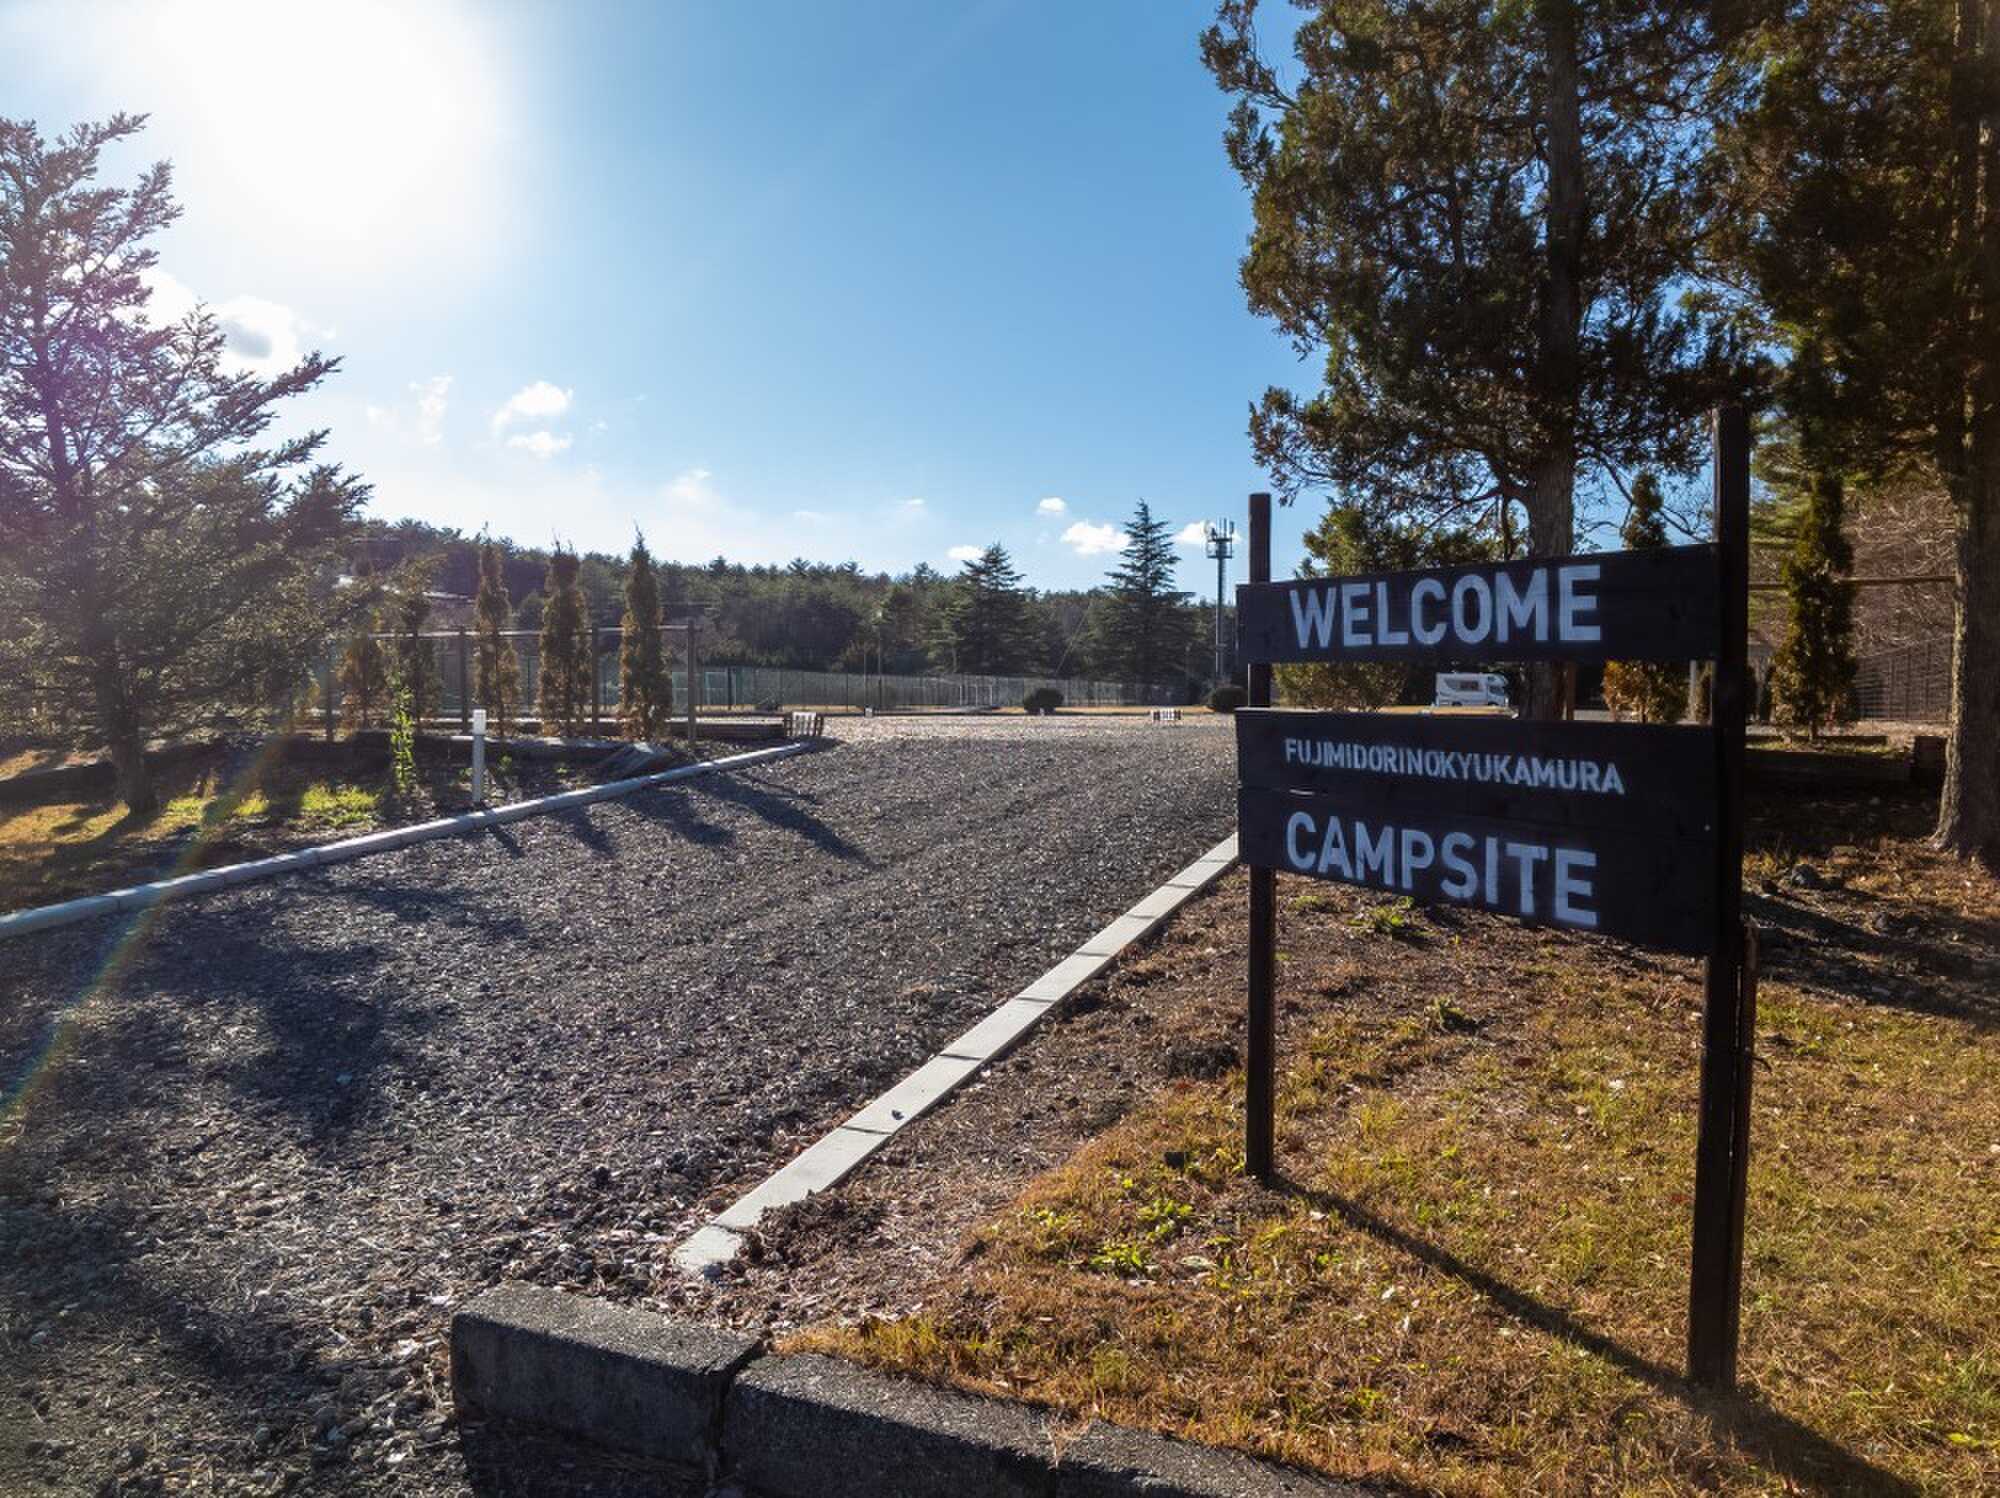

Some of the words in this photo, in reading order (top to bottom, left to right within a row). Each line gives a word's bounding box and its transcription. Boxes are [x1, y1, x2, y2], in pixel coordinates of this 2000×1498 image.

[1289, 564, 1601, 649] WELCOME
[1284, 738, 1625, 796] FUJIMIDORINOKYUKAMURA
[1286, 811, 1598, 927] CAMPSITE
